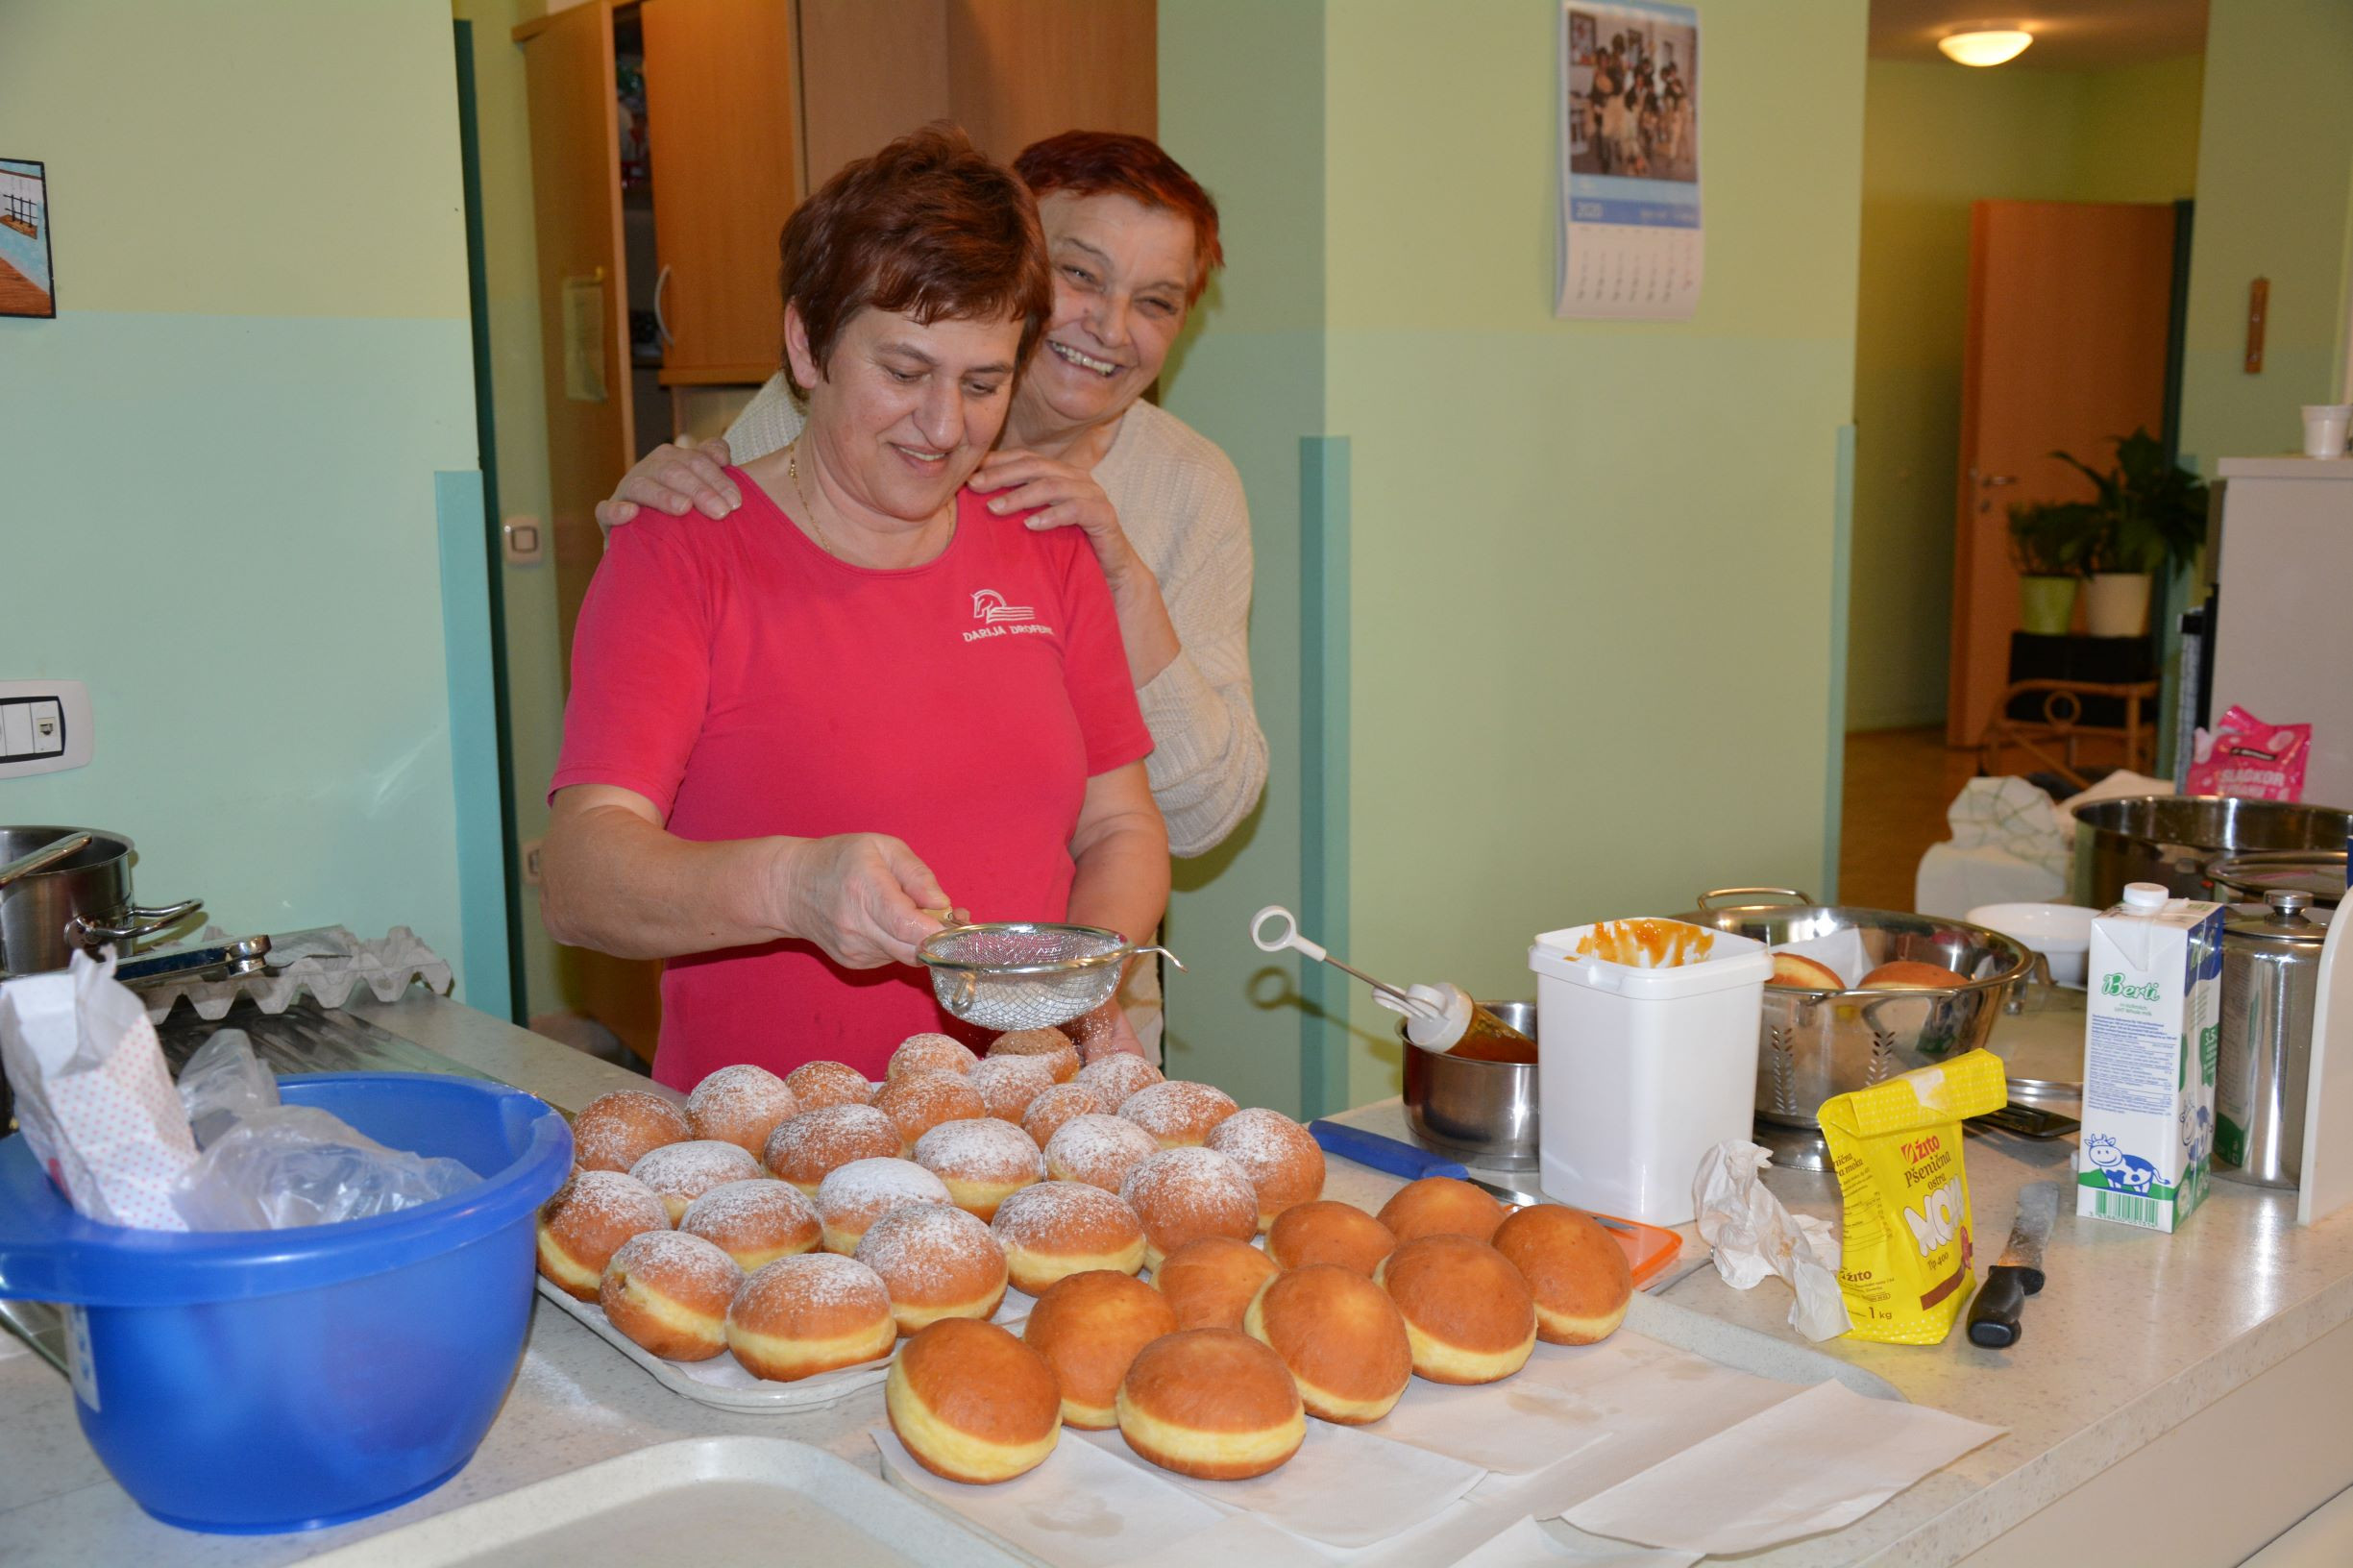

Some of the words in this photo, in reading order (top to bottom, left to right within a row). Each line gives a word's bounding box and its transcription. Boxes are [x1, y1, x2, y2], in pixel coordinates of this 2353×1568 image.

[963, 625, 1006, 642] DARIJA
[2101, 972, 2161, 1001] Berti
[1904, 1151, 1951, 1188] Pšenična
[1927, 1172, 1947, 1190] ostra
[1869, 1307, 1875, 1319] 1
[1878, 1311, 1893, 1320] kg
